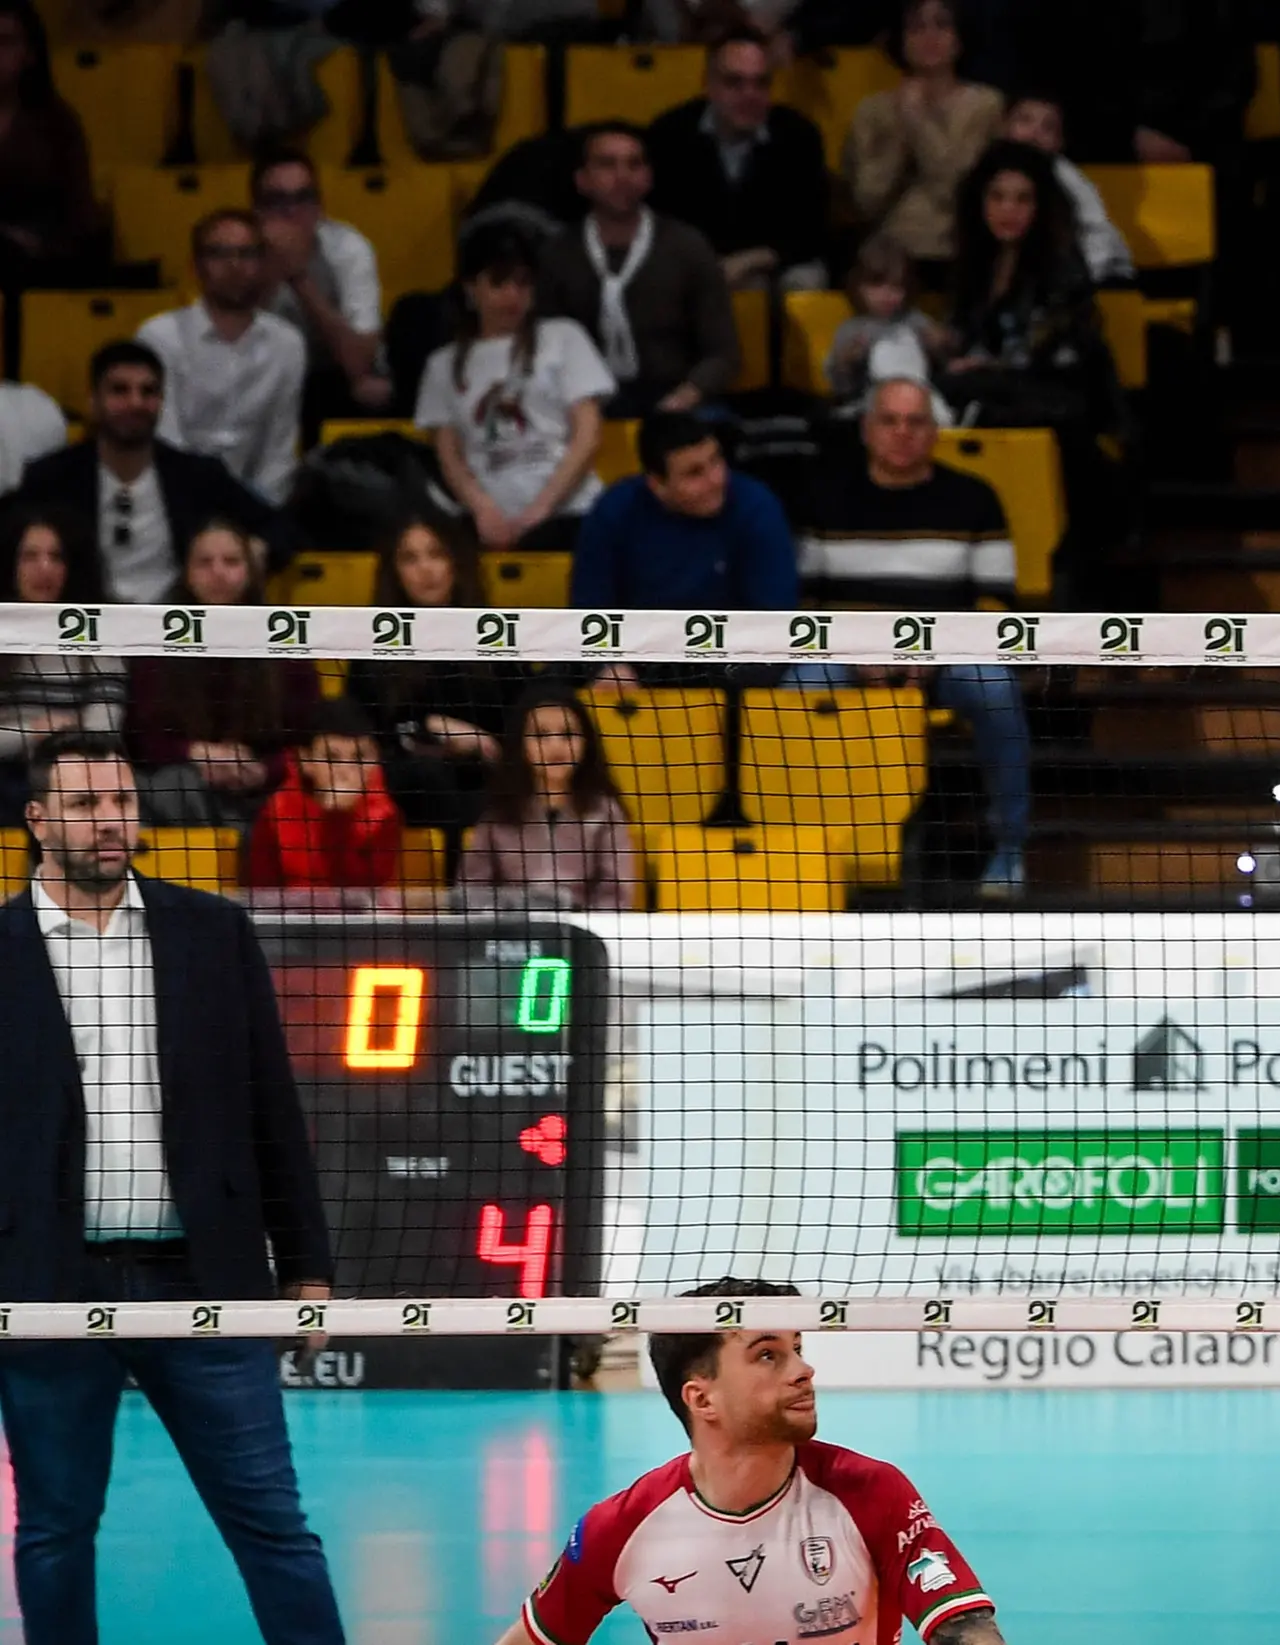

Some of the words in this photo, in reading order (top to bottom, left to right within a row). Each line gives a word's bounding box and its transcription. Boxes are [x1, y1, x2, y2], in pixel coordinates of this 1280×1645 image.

[346, 967, 424, 1068] 0
[518, 958, 571, 1033] 0
[450, 1054, 572, 1097] GUEST
[858, 1041, 1108, 1091] Polimeni
[915, 1155, 1208, 1211] GAROFOLI
[477, 1205, 552, 1298] 4
[915, 1332, 1095, 1380] Reggio
